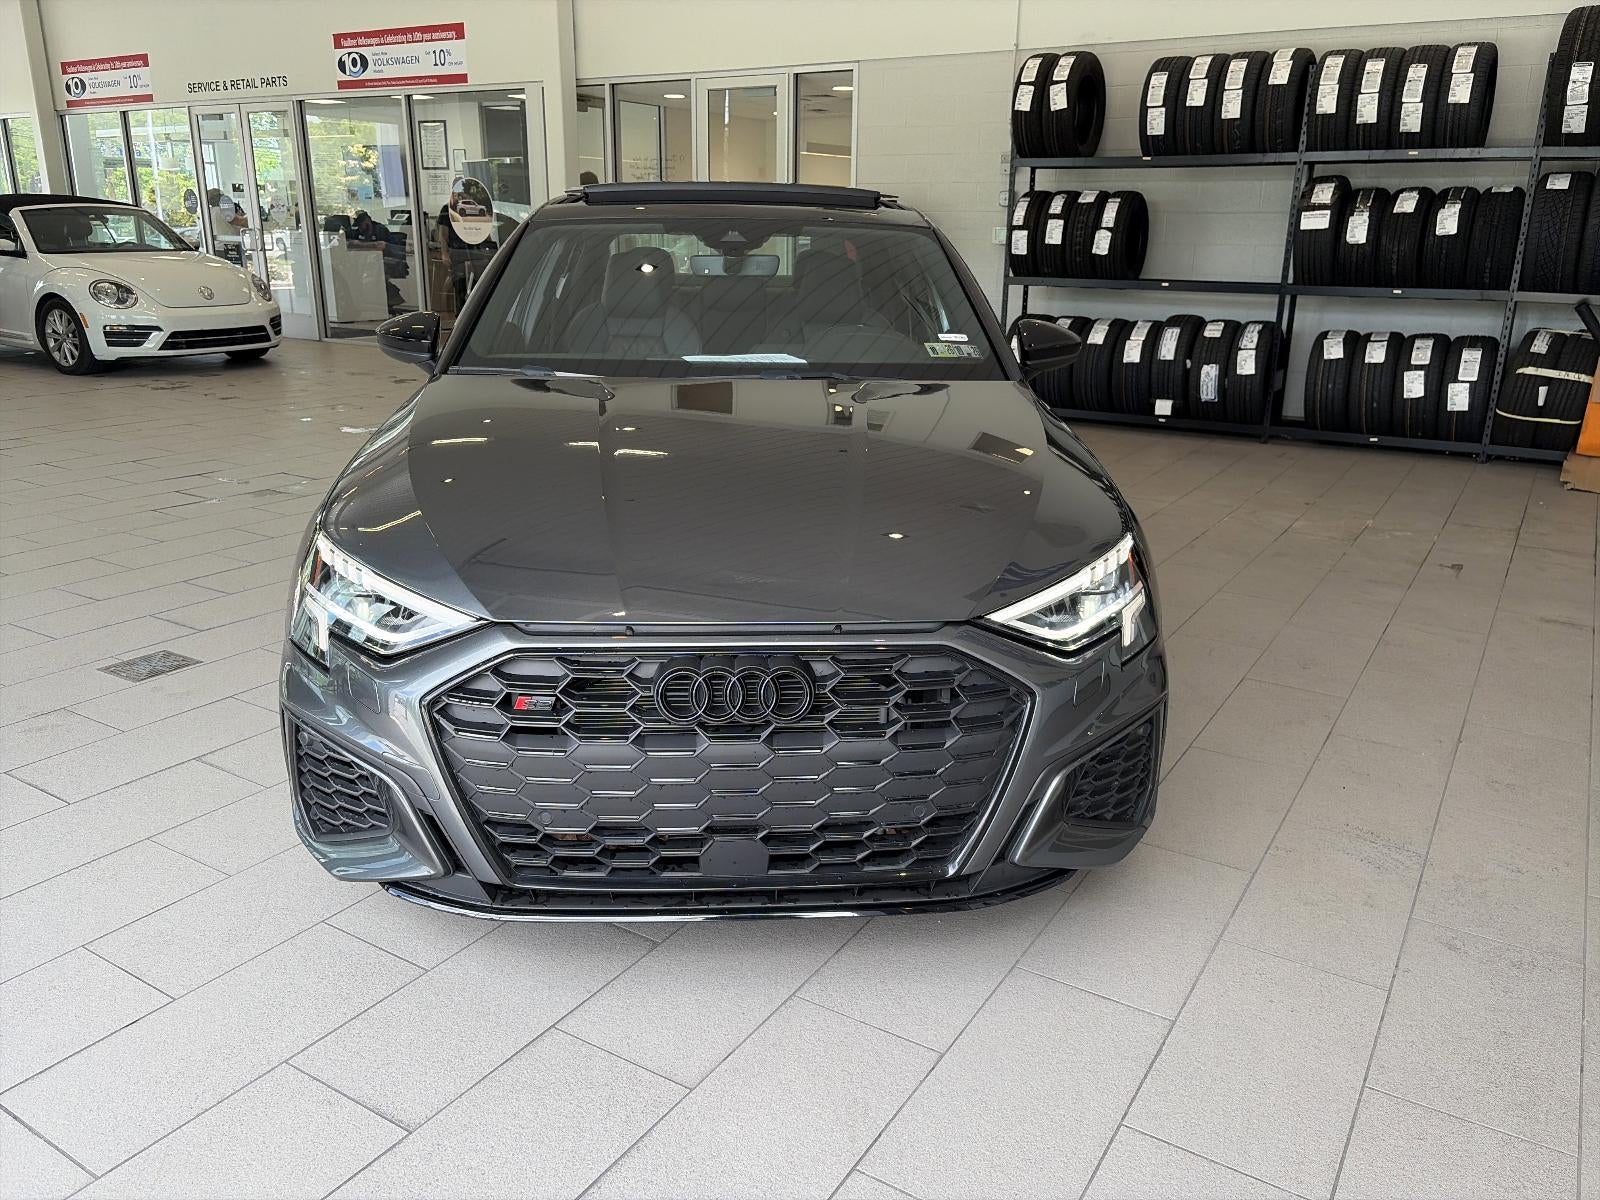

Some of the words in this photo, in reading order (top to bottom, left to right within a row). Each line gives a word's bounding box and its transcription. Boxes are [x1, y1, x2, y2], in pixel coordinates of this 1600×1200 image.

[357, 36, 380, 47] Volkswagen
[384, 33, 406, 44] Celebrating
[412, 31, 422, 41] 10th
[423, 32, 431, 43] year
[372, 55, 420, 67] VOLKSWAGEN
[88, 79, 121, 89] VOLKSWAGEN
[187, 80, 220, 94] SERVICE
[222, 80, 228, 91] &
[230, 78, 258, 90] RETAIL
[260, 75, 288, 88] PARTS
